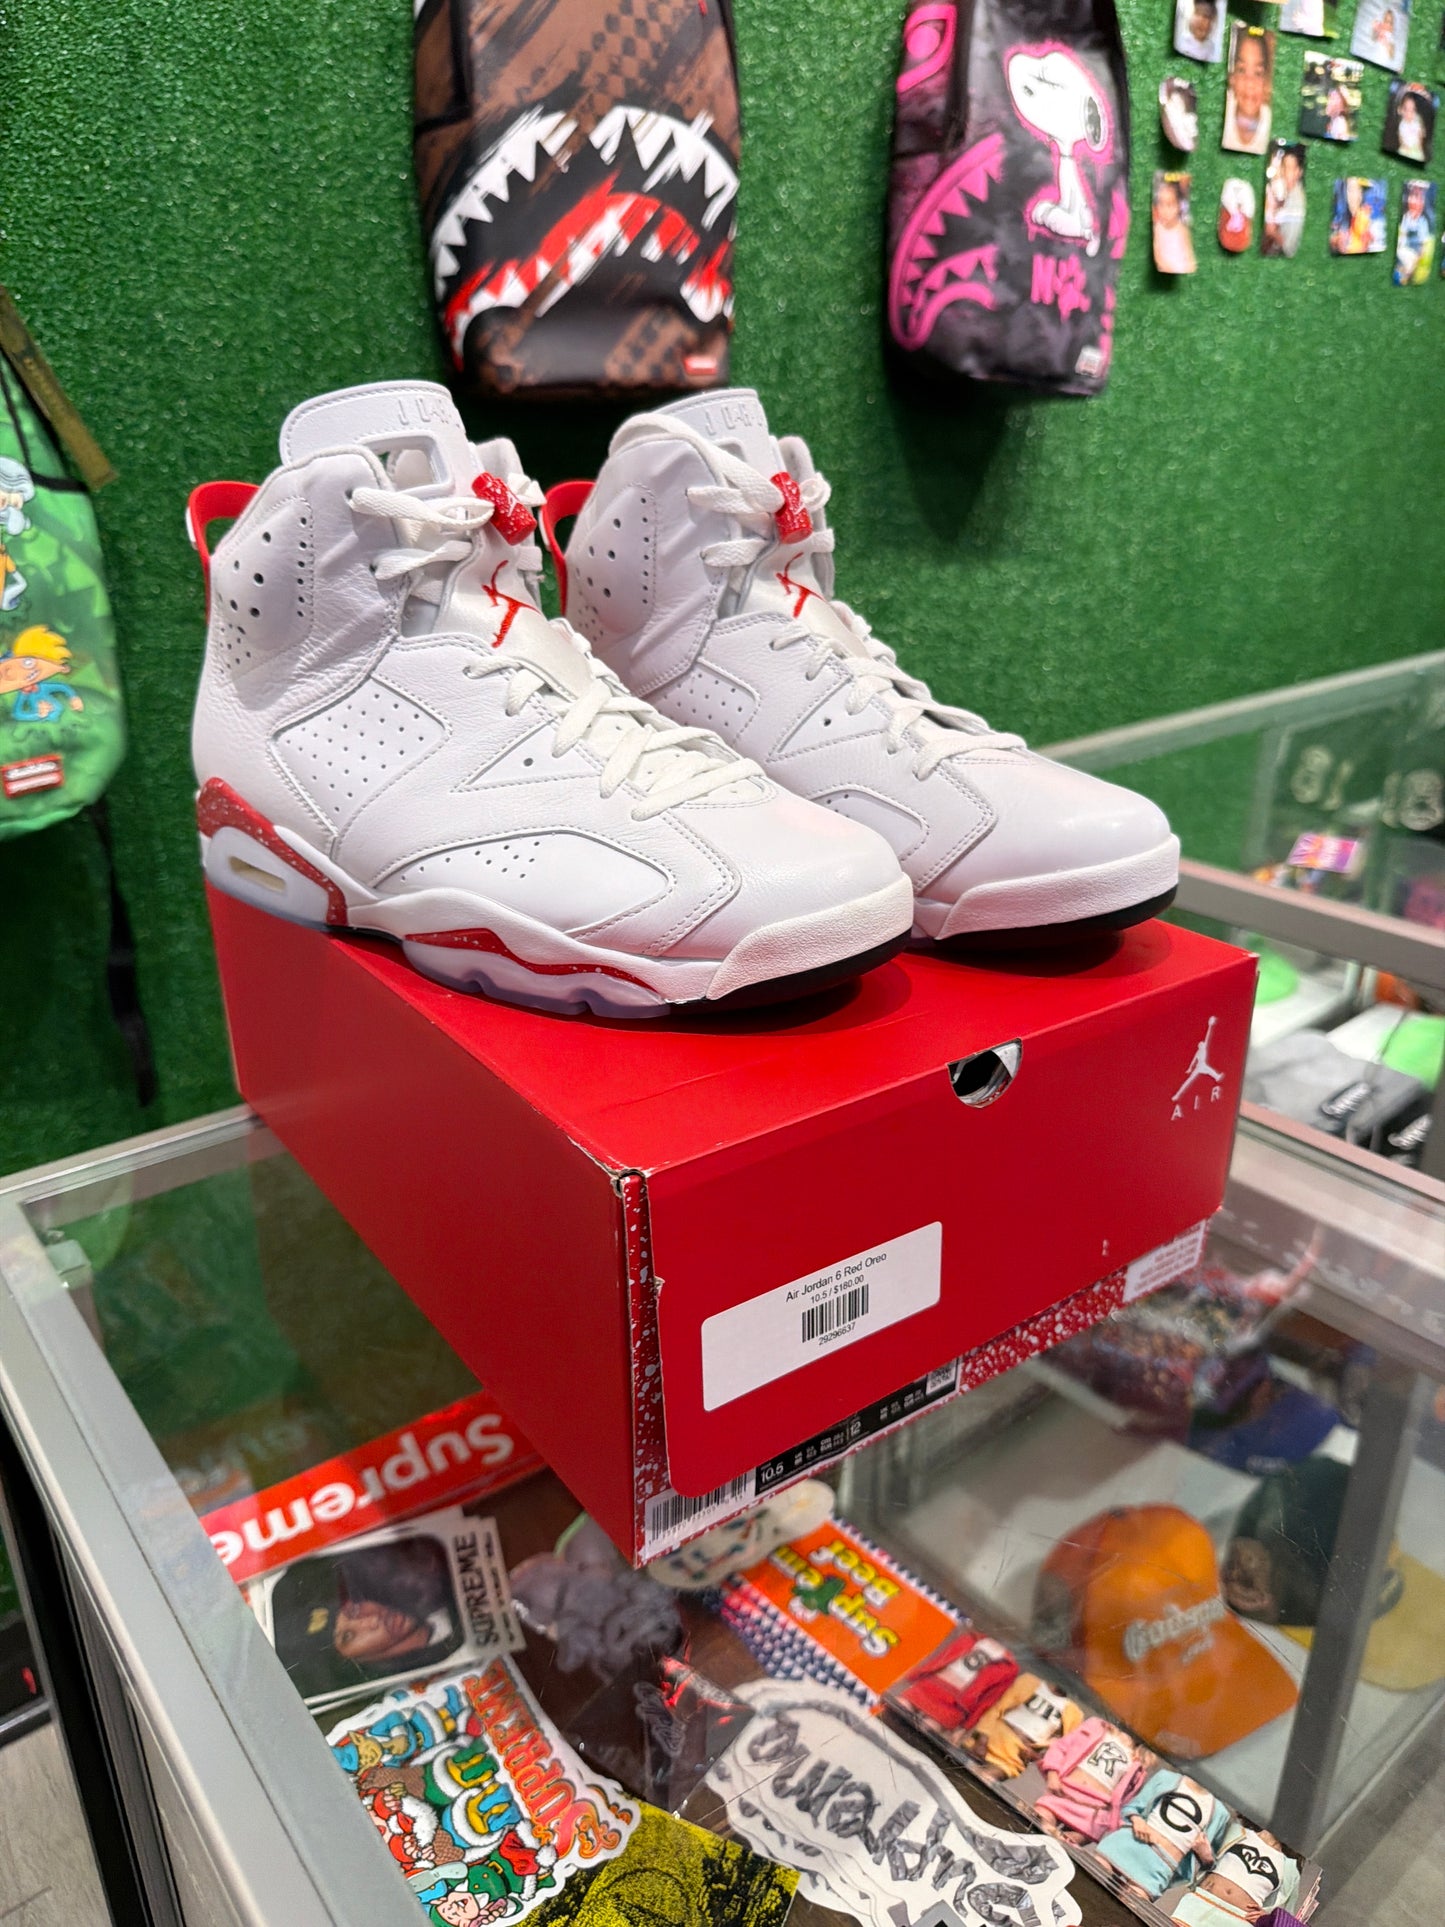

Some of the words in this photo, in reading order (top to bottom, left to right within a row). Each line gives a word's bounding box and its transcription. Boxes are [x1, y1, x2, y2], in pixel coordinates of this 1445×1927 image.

[1170, 1085, 1222, 1121] AIR
[785, 1290, 799, 1303] Air
[801, 1274, 834, 1296] Jordan
[835, 1270, 843, 1281] 6
[844, 1260, 864, 1278] Red
[864, 1252, 888, 1268] Oreo
[810, 1291, 828, 1304] 10.5
[833, 1274, 865, 1296] $180.00
[818, 1322, 857, 1346] 29296637
[850, 1420, 862, 1437] 12
[209, 1413, 514, 1566] Supreme
[761, 1460, 785, 1484] 10.5
[454, 1531, 498, 1646] SUPREME
[808, 1539, 900, 1609] Beef
[1025, 1693, 1063, 1721] UP
[1158, 1790, 1203, 1834] e
[1240, 1847, 1272, 1875] ME
